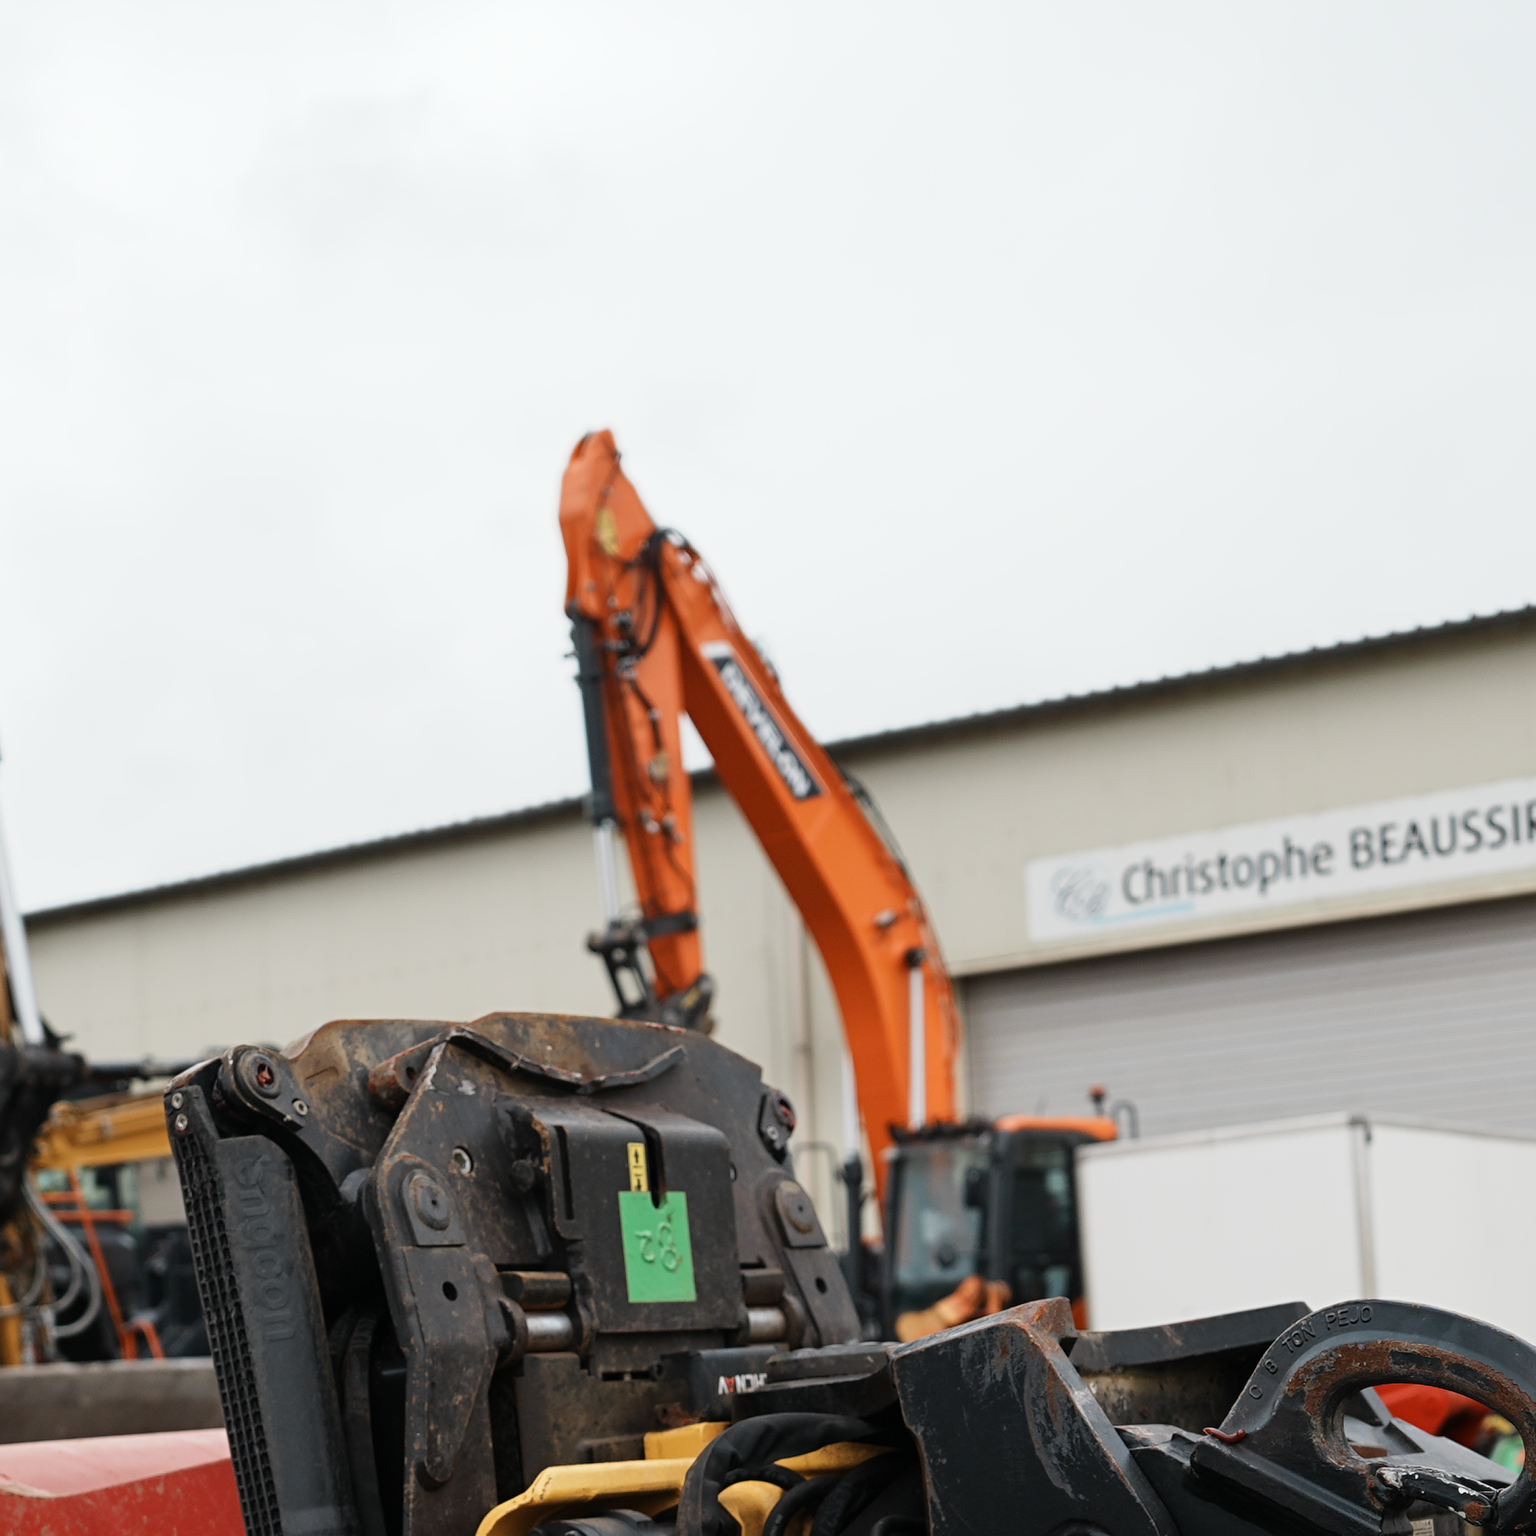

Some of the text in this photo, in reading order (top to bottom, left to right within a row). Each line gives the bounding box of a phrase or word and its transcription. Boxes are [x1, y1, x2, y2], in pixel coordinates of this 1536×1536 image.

[1120, 836, 1336, 906] Christophe
[1282, 1320, 1316, 1353] TON
[1325, 1305, 1373, 1330] PEJO
